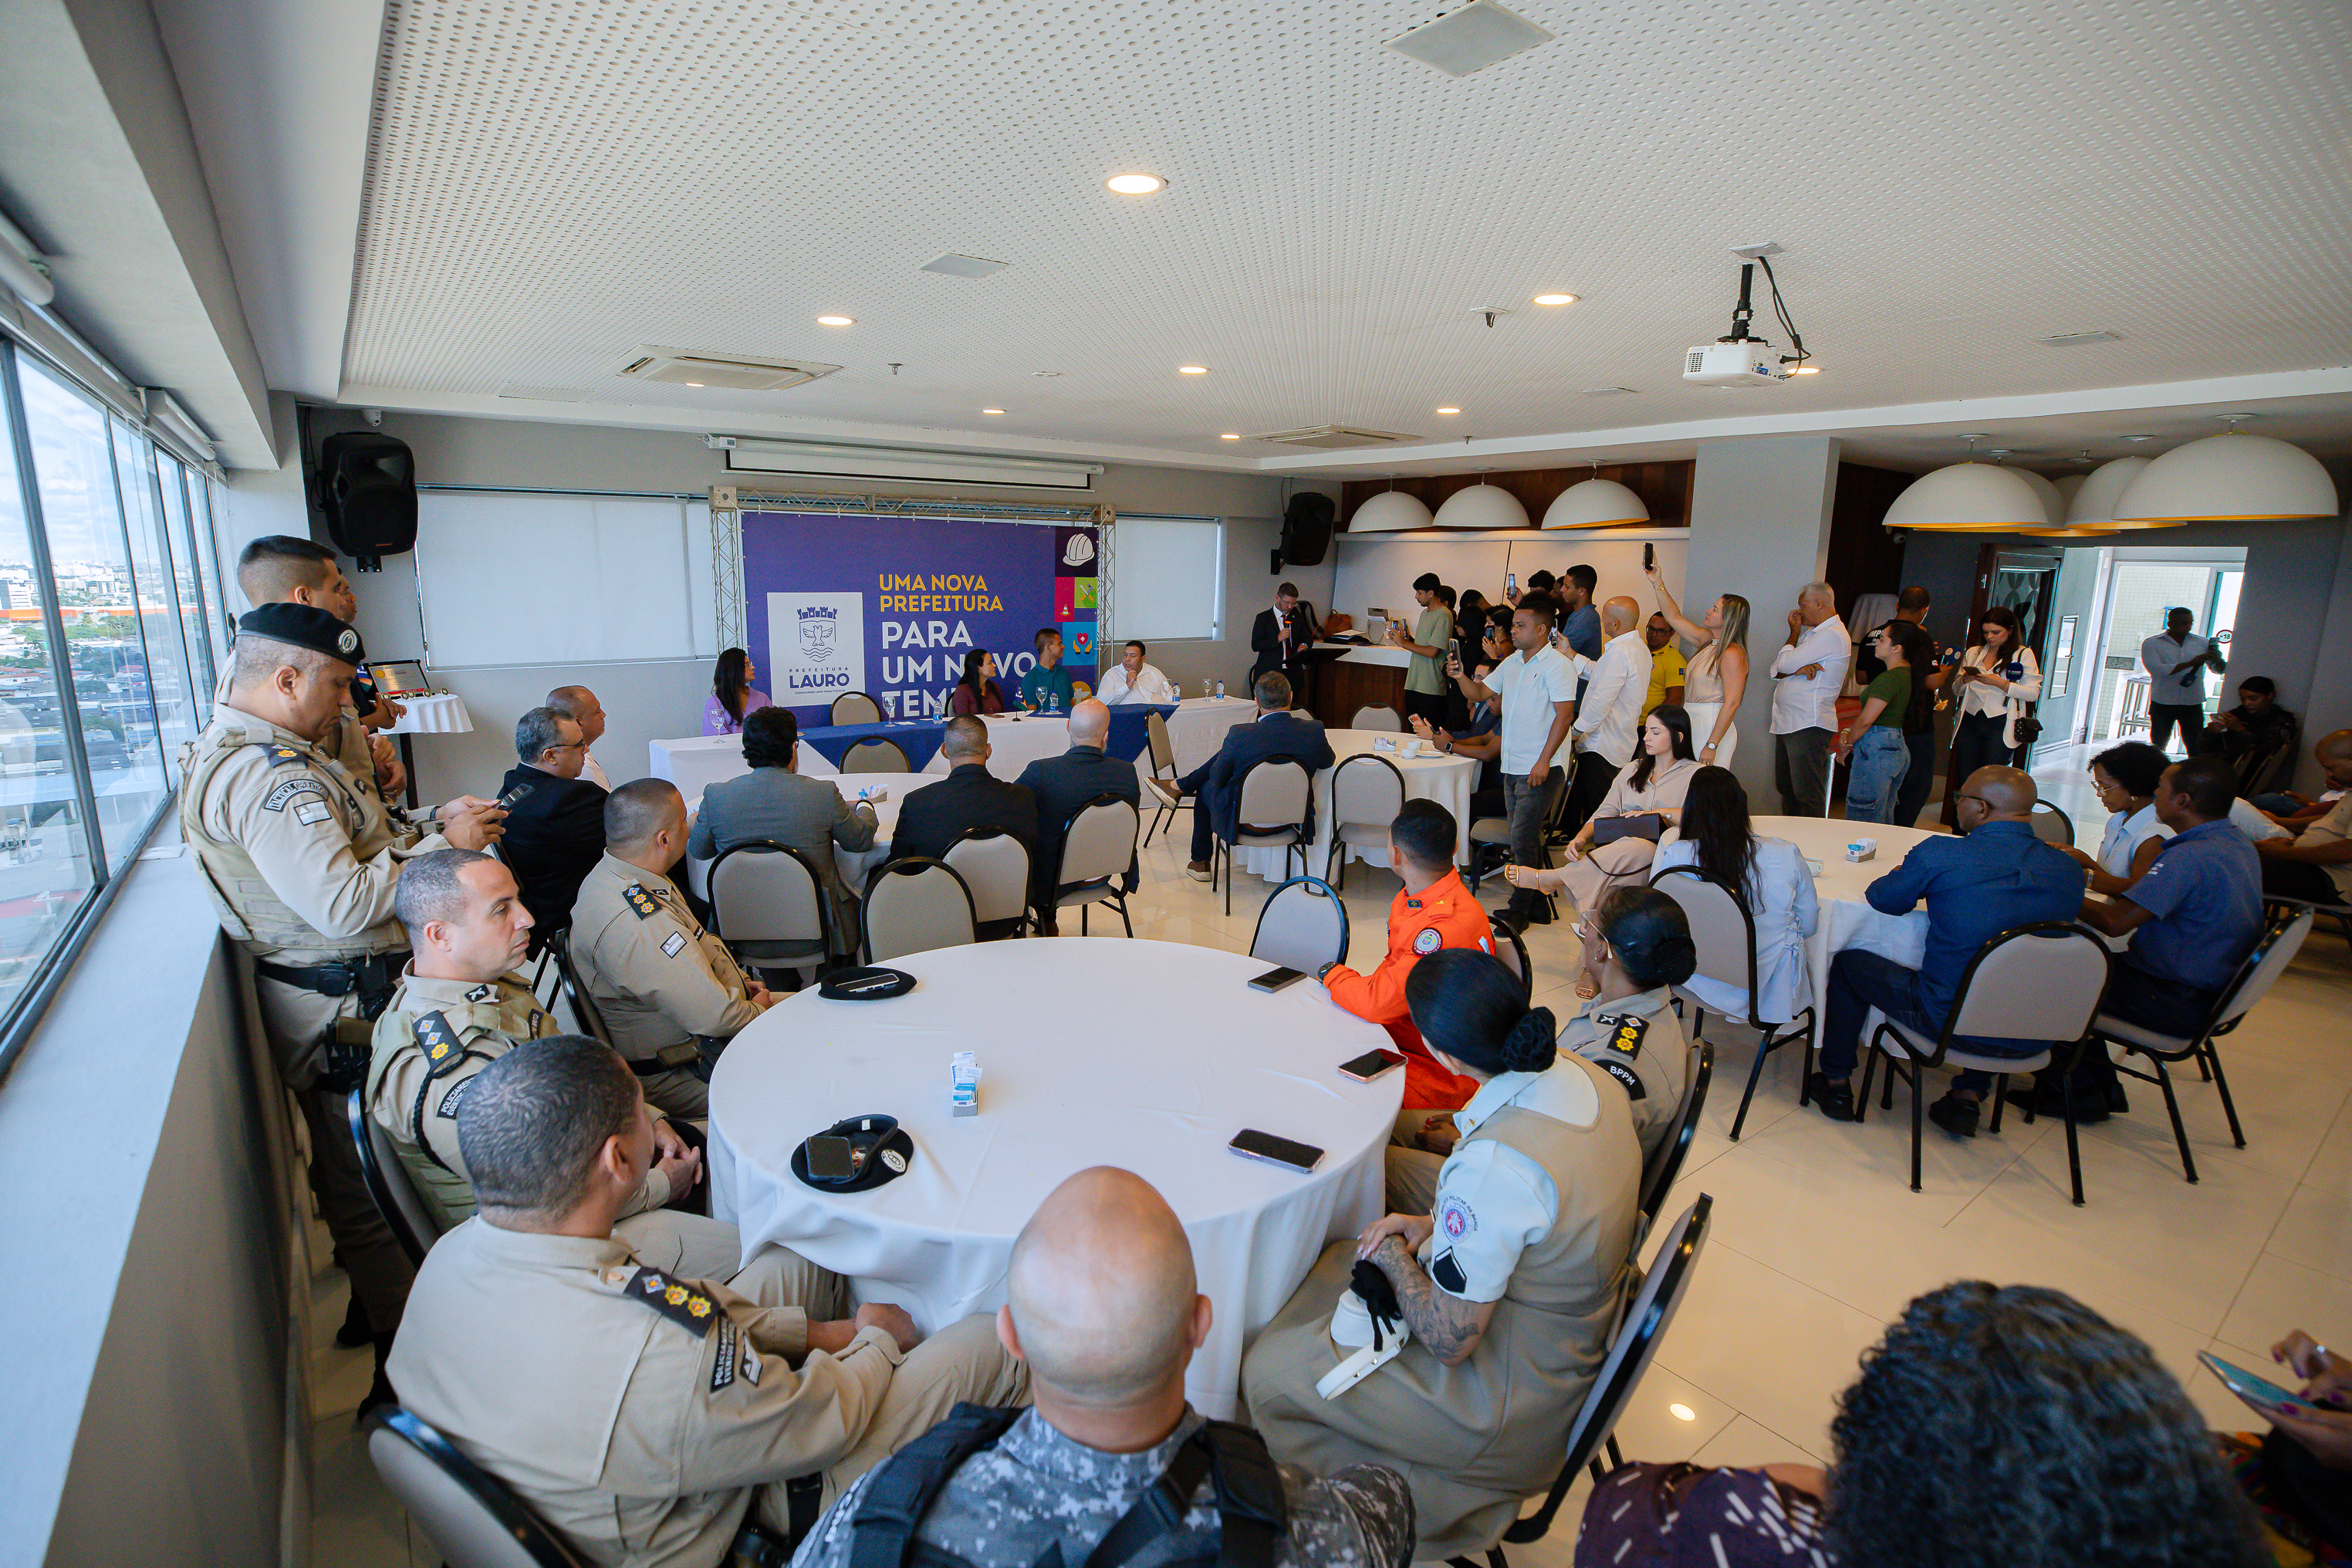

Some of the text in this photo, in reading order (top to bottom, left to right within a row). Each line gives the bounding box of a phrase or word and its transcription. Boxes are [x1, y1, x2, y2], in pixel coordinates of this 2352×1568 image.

[879, 574, 988, 591] UMA NOVA
[880, 595, 1004, 612] PREFEITURA
[881, 620, 974, 649] PARA
[882, 651, 1037, 684] UM NVO
[789, 673, 850, 688] LAURO
[881, 688, 956, 718] TEM
[268, 782, 297, 809] TACTICAL
[1610, 1066, 1635, 1086] BPPM
